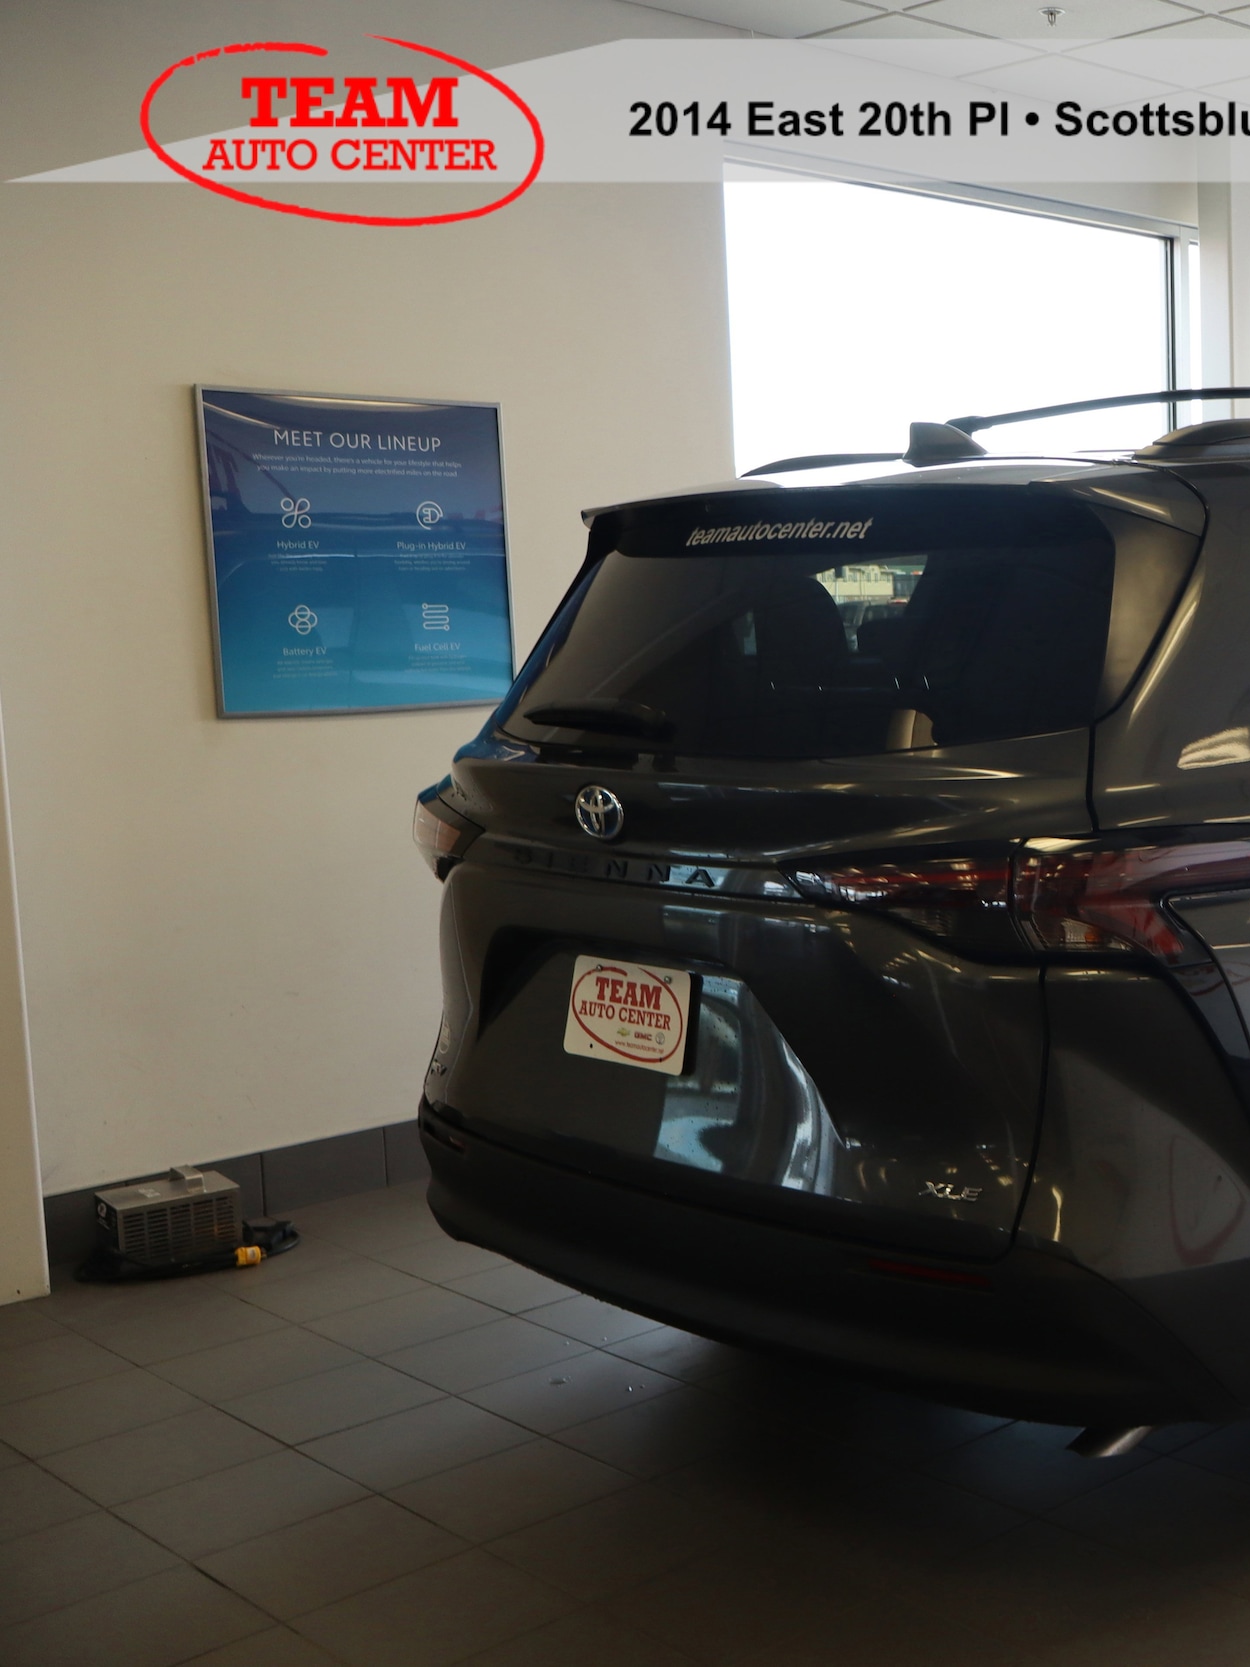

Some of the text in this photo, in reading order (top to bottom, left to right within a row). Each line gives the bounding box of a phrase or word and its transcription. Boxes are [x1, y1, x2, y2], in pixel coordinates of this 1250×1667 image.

[274, 429, 441, 452] MEET OUR LINEUP
[252, 453, 284, 461] Wherever
[256, 464, 270, 472] you
[323, 466, 332, 474] by
[432, 469, 442, 477] the
[686, 517, 874, 547] teamautocenter.net
[276, 540, 320, 551] Hybrid EV
[396, 541, 466, 551] Plug-in Hybrid EV
[282, 646, 327, 656] Battery EV
[414, 642, 461, 652] Fuel Cell EV
[595, 976, 662, 1010] TEAM
[579, 1000, 671, 1031] AUTO CENTER
[634, 1031, 653, 1042] GMC
[918, 1181, 983, 1202] XLE
